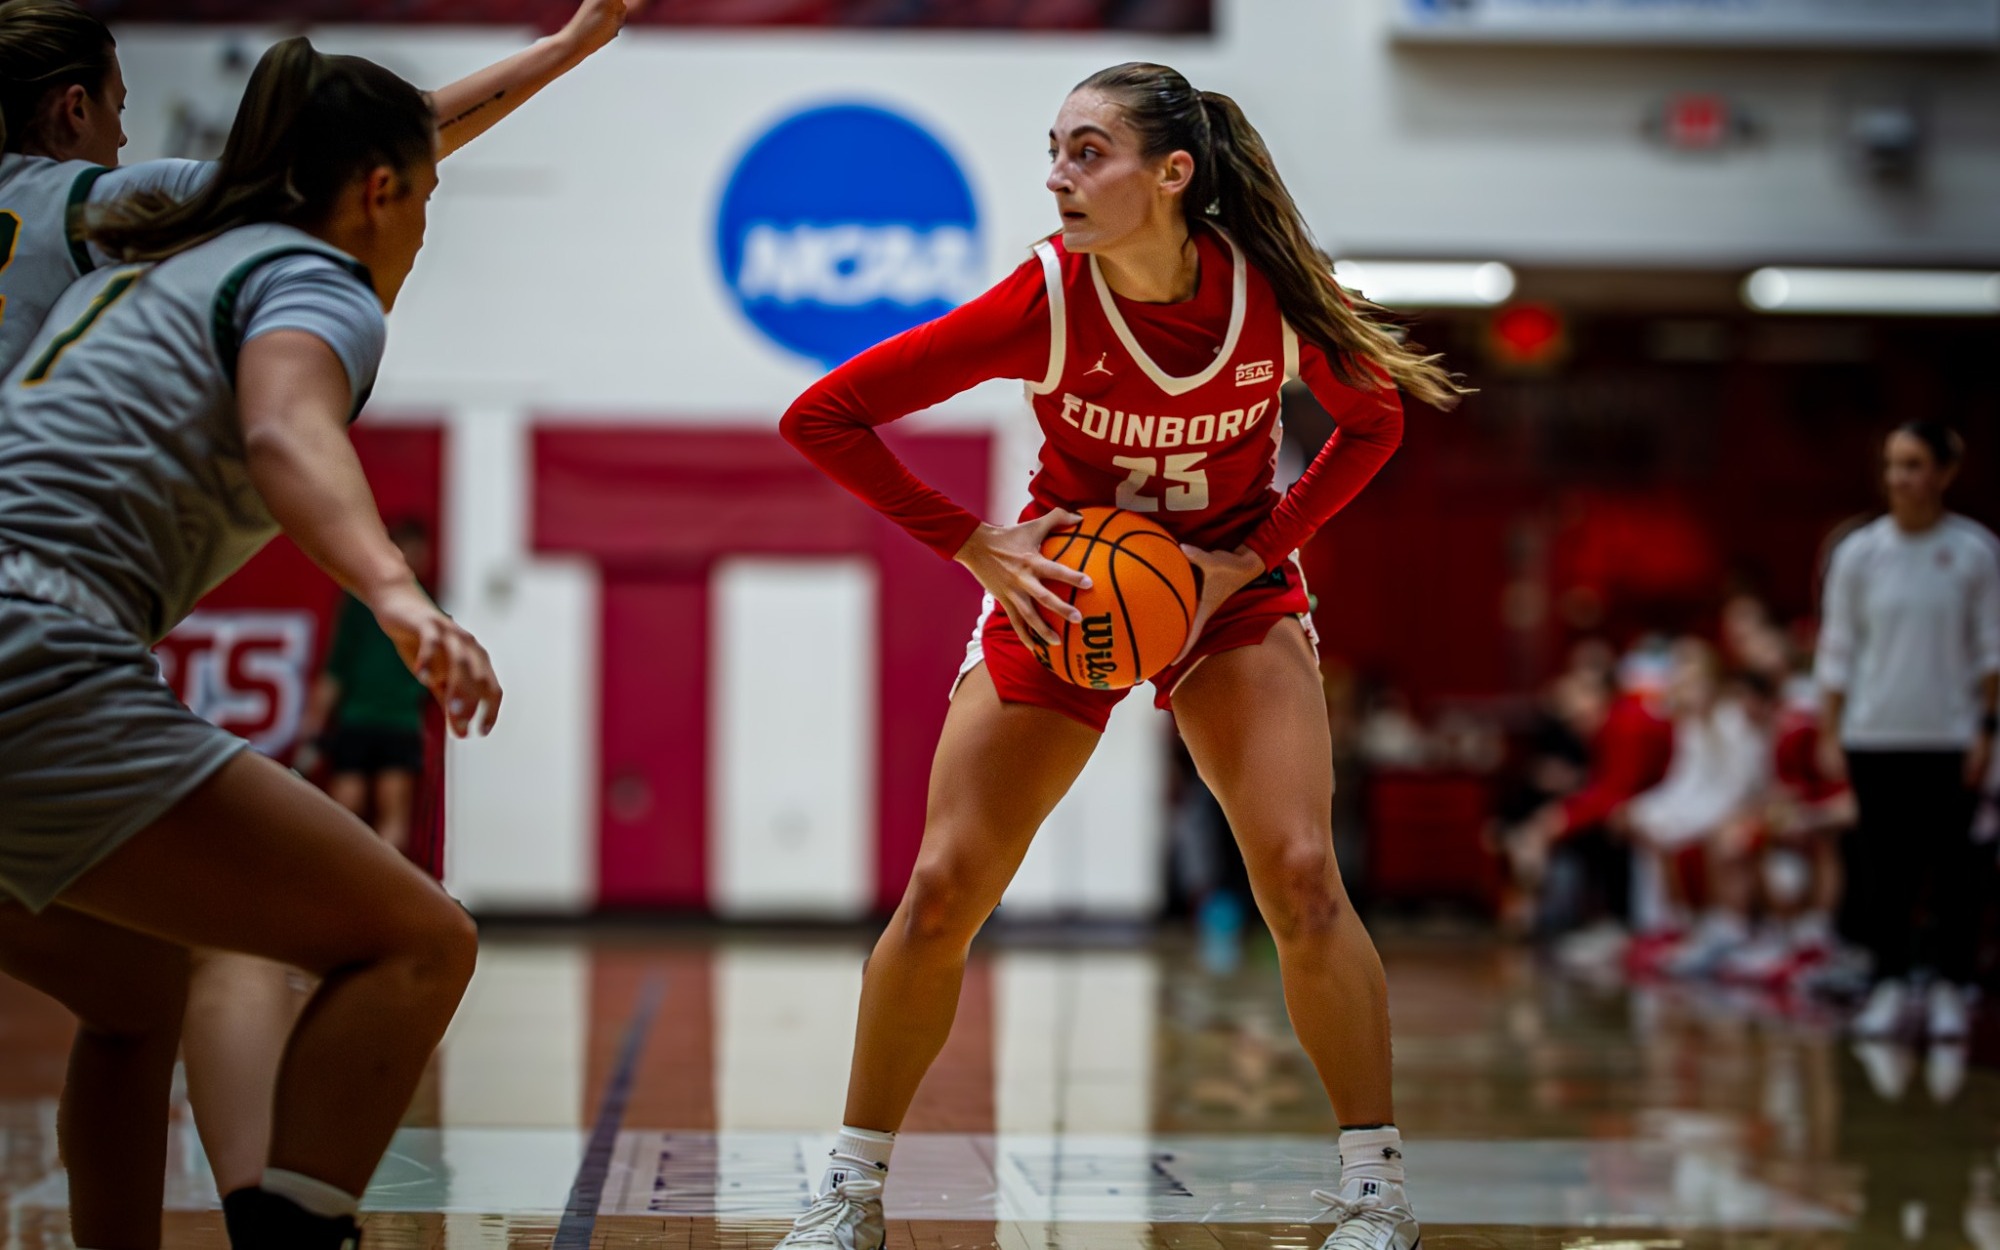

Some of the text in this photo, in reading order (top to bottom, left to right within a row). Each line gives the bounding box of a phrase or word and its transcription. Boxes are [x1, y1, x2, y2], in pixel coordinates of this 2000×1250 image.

[1235, 364, 1273, 382] PSAC
[1060, 392, 1270, 448] EDINBORO
[1112, 451, 1209, 513] 25
